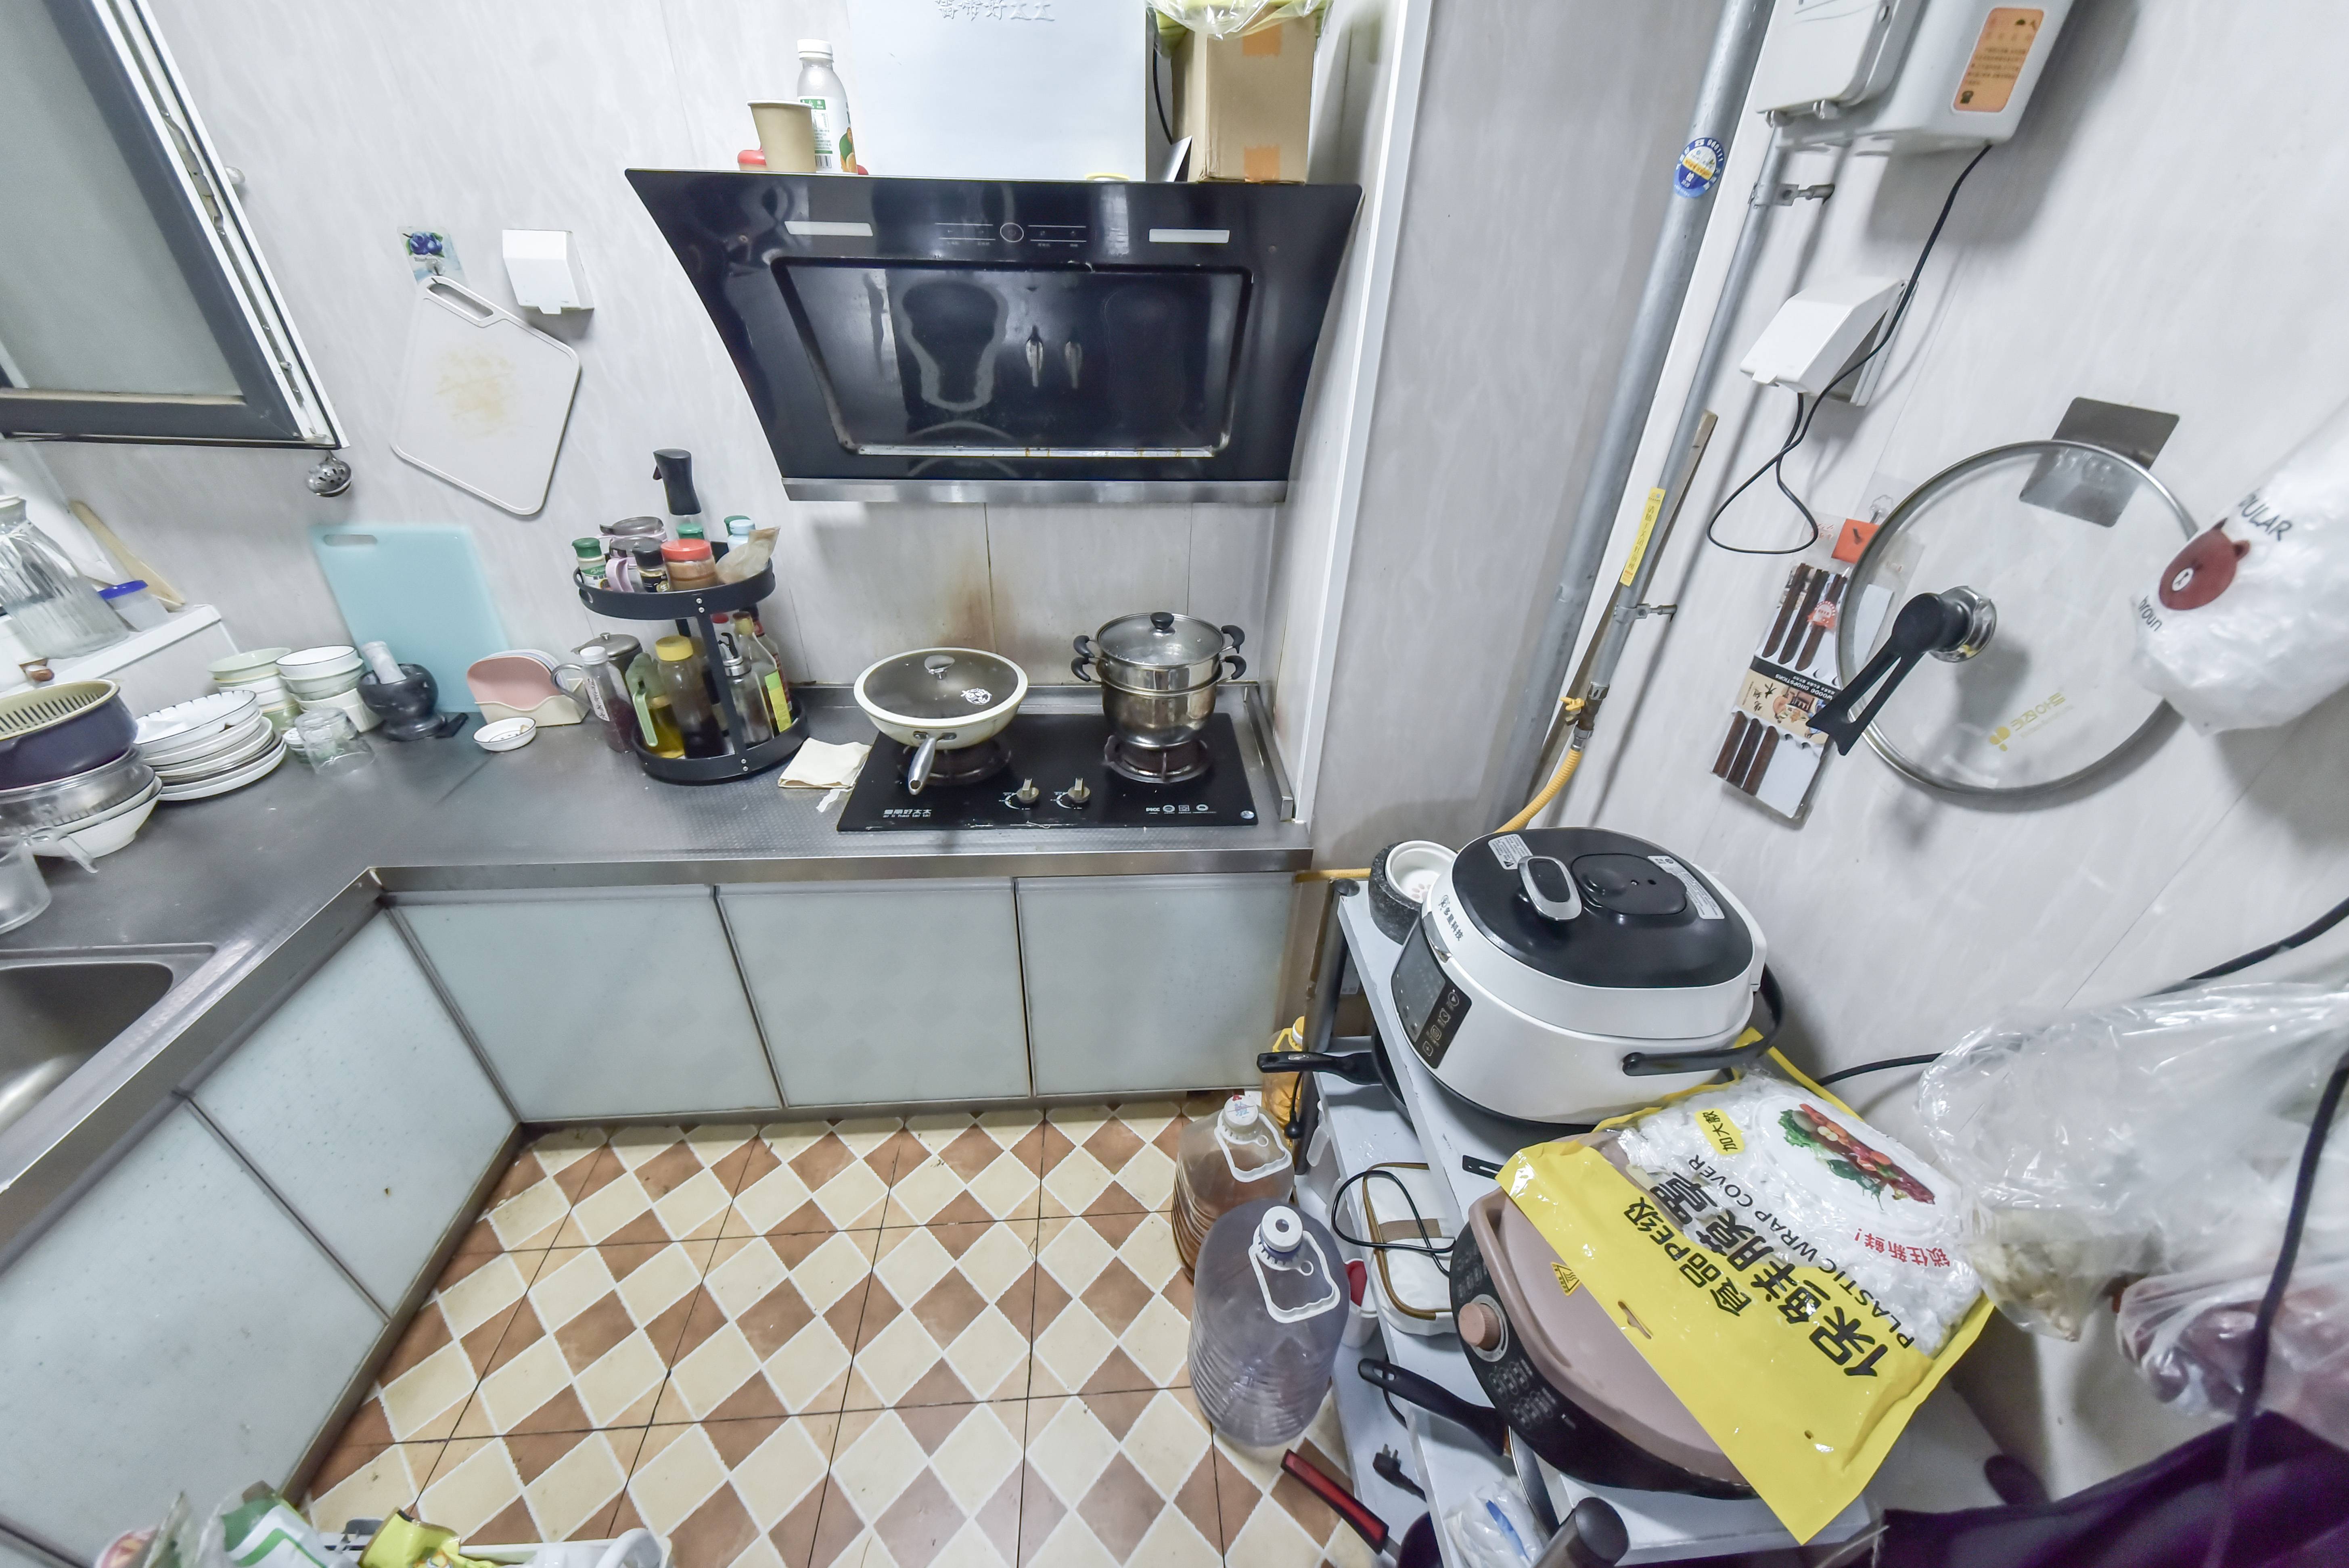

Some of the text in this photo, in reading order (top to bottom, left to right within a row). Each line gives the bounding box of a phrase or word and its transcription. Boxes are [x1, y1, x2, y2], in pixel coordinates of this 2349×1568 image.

[1705, 1111, 1738, 1152] 加大款
[1623, 1196, 1753, 1317] 食品PE级
[1650, 1171, 1889, 1377] 保鲜膜罩
[1688, 1154, 1915, 1349] PLASTIC WRAP COVER
